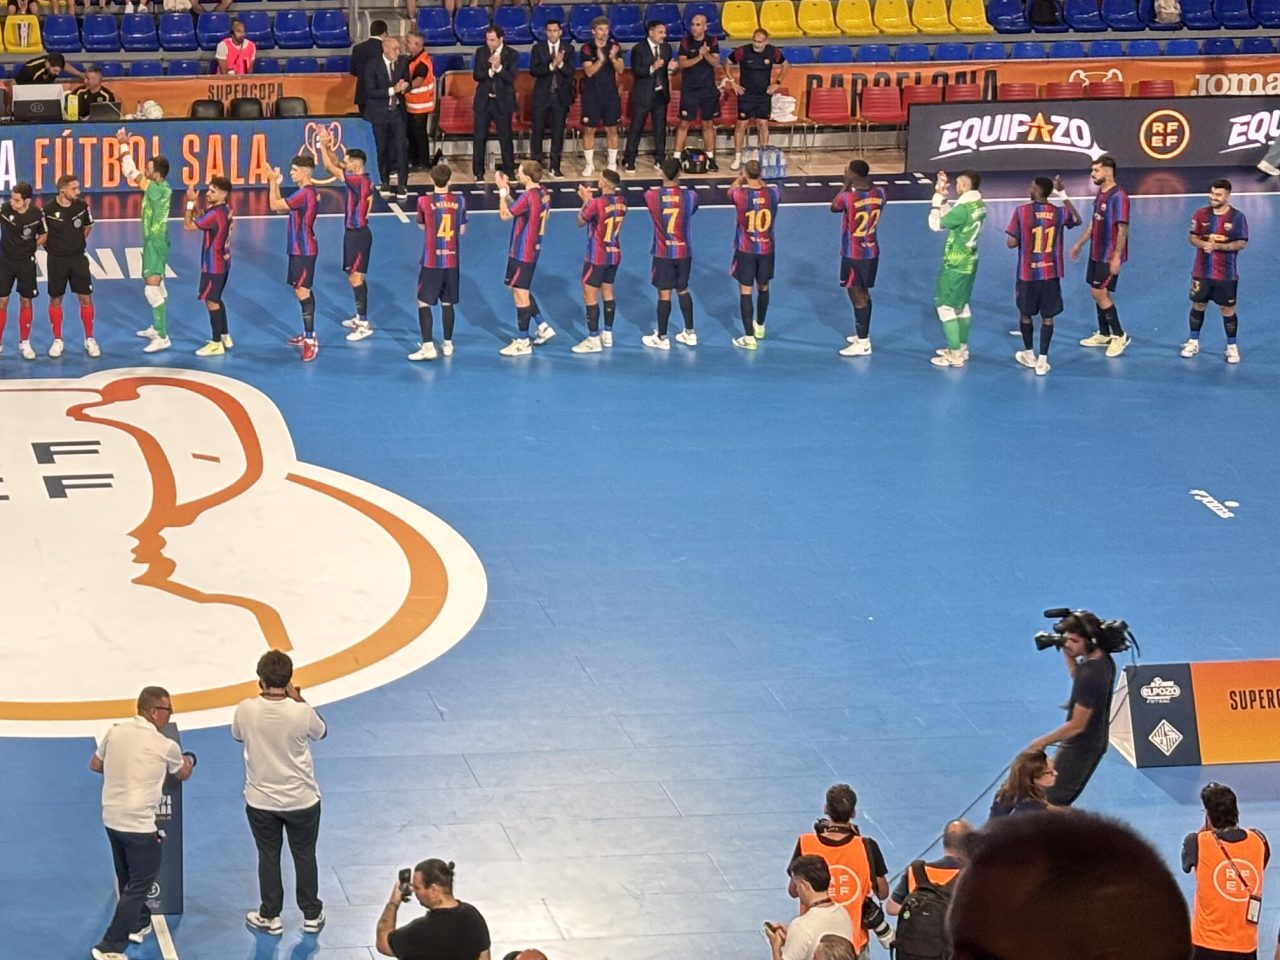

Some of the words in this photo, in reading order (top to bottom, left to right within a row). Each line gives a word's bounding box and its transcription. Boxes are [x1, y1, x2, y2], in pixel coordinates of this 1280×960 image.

[208, 82, 284, 100] SUPERCOPA
[938, 112, 1091, 153] EQUIPAZO
[182, 133, 268, 185] SALA
[437, 214, 454, 241] 4
[662, 208, 680, 234] 7
[745, 208, 772, 233] 10
[852, 209, 881, 237] 22
[1031, 226, 1055, 253] 11
